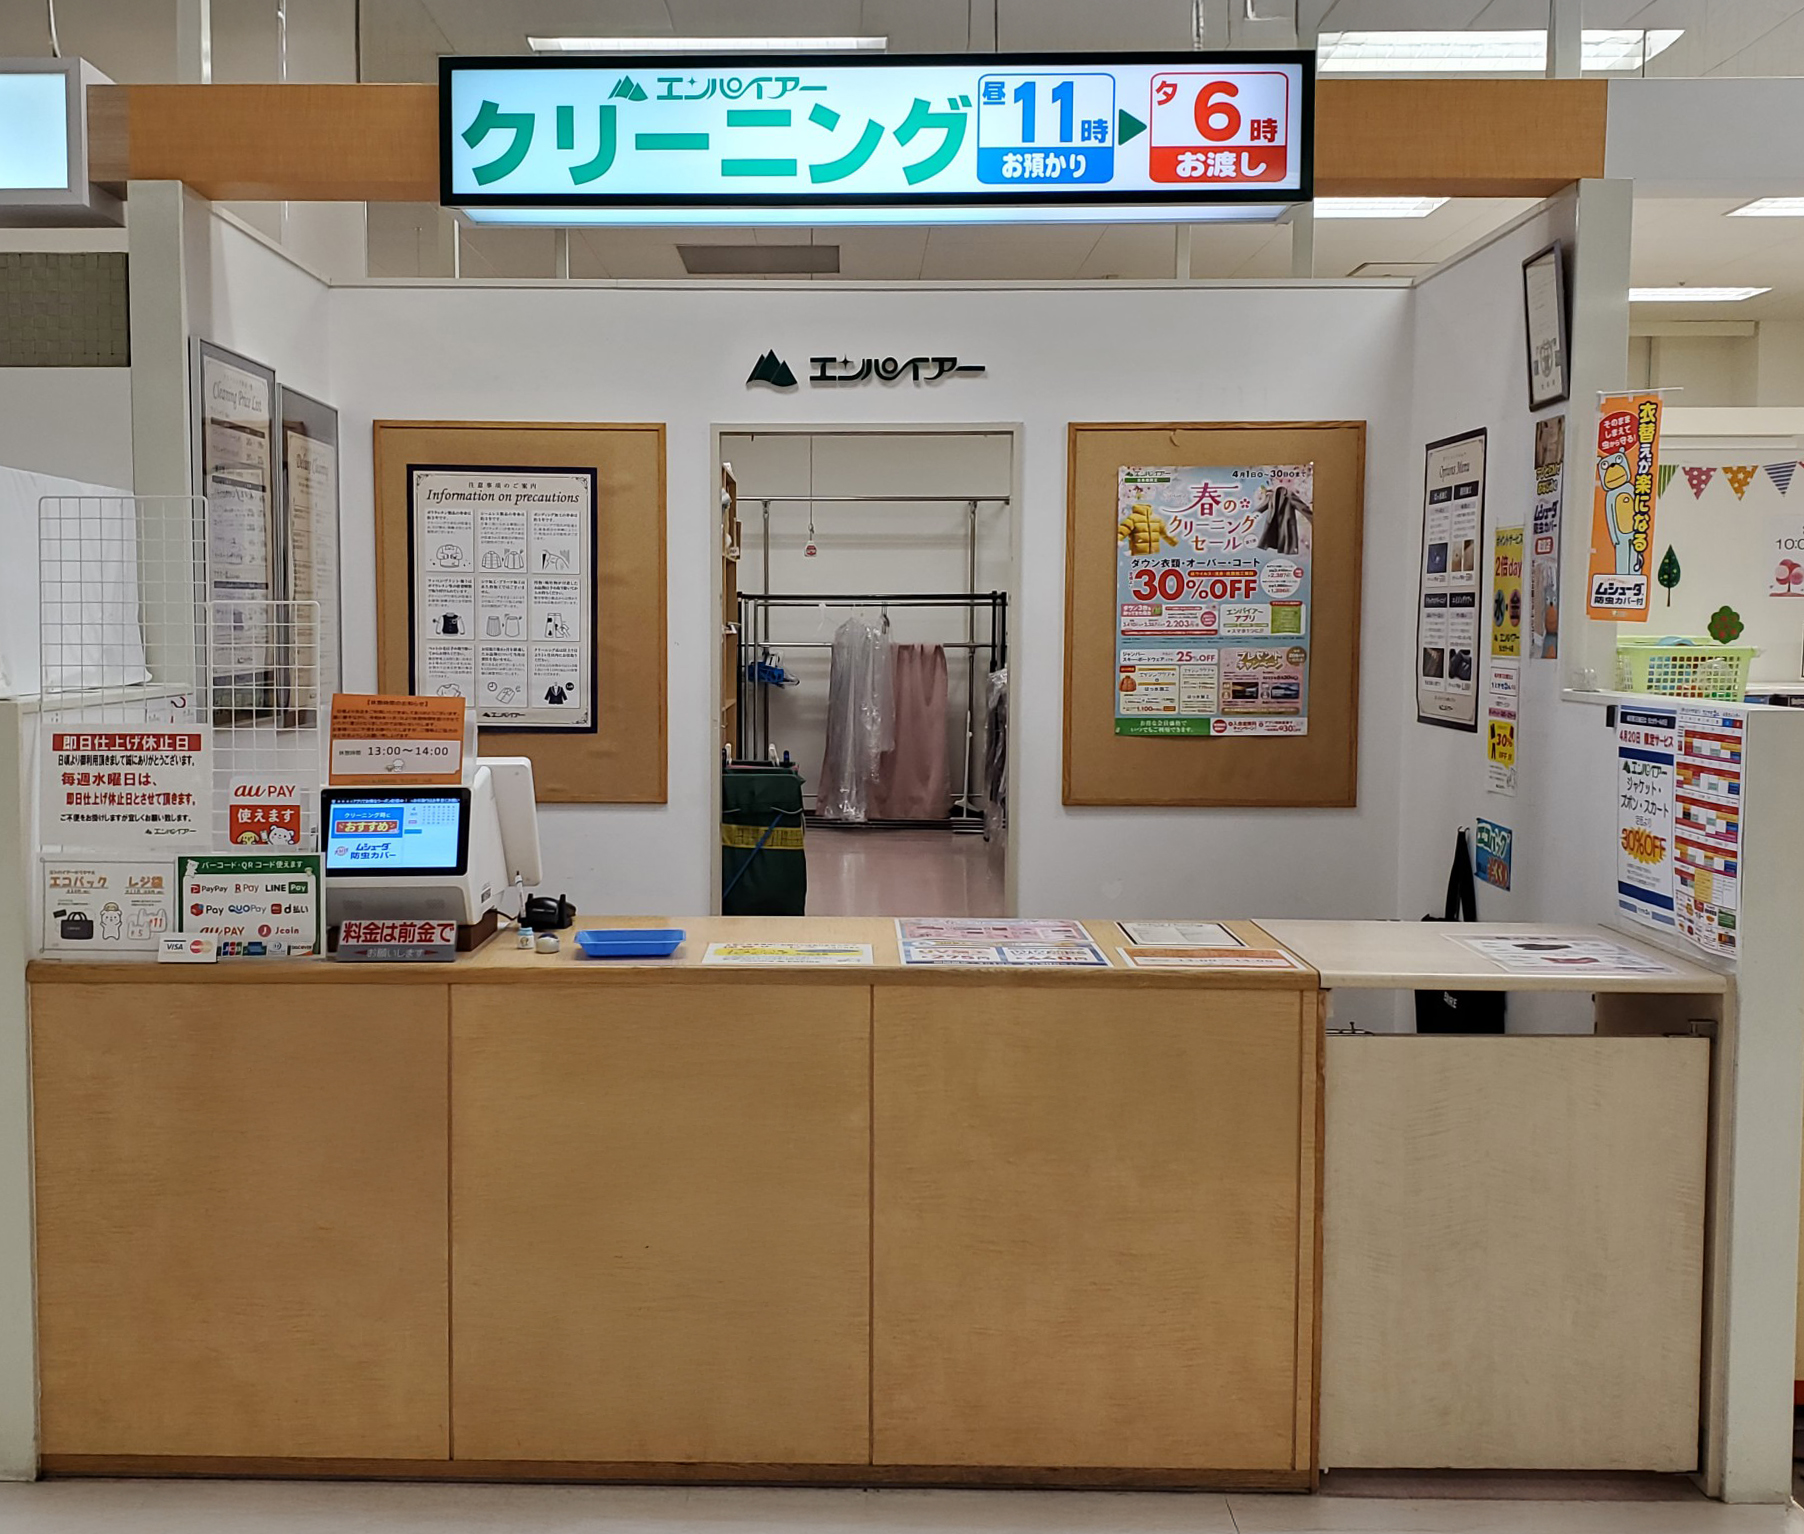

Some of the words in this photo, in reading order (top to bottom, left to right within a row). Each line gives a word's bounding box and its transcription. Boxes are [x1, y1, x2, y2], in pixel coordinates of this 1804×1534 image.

[656, 76, 828, 100] エンパイアー
[982, 81, 1006, 105] 昼
[1013, 80, 1109, 143] 11時
[1155, 80, 1178, 106] 夕
[1193, 80, 1279, 142] 6時
[461, 94, 972, 187] クリーニング
[1001, 152, 1087, 179] お預かり
[1176, 151, 1267, 178] お渡し
[809, 354, 986, 382] エンパイアー
[1603, 415, 1631, 428] そのまま
[1604, 425, 1632, 438] しまえて
[1633, 400, 1658, 552] 衣替えが楽になる
[426, 488, 496, 504] Information
[498, 492, 512, 502] on
[514, 489, 579, 505] precautions
[1161, 482, 1237, 517] 春の
[1169, 514, 1259, 537] クリーニング
[1192, 535, 1243, 551] セール
[1131, 557, 1261, 569] ダウン衣類・オーバー・コート
[1132, 569, 1257, 601] 30%OFF
[1594, 582, 1644, 596] ムシューダ
[1593, 595, 1644, 606] 防虫カバー付
[62, 735, 189, 751] 即日仕上げ休止日
[1619, 730, 1641, 744] 4月20日
[61, 772, 158, 786] 毎週水曜日は、
[66, 792, 196, 806] 即日仕上げ休止日とさせて頂きます。
[234, 785, 266, 798] au
[267, 785, 296, 798] PAY
[237, 808, 295, 824] 使えます
[344, 822, 389, 832] おすすめ
[1620, 827, 1667, 859] 30%OFF
[350, 852, 397, 860] 防虫カバー
[201, 885, 228, 894] PayPay
[243, 884, 259, 893] Pay
[265, 884, 286, 892] LINE
[290, 884, 306, 892] Pay
[206, 904, 224, 916] Pay
[224, 927, 245, 936] PAY
[342, 921, 455, 943] 料金は前金で
[166, 943, 184, 951] VISA
[366, 948, 425, 959] お願いします
